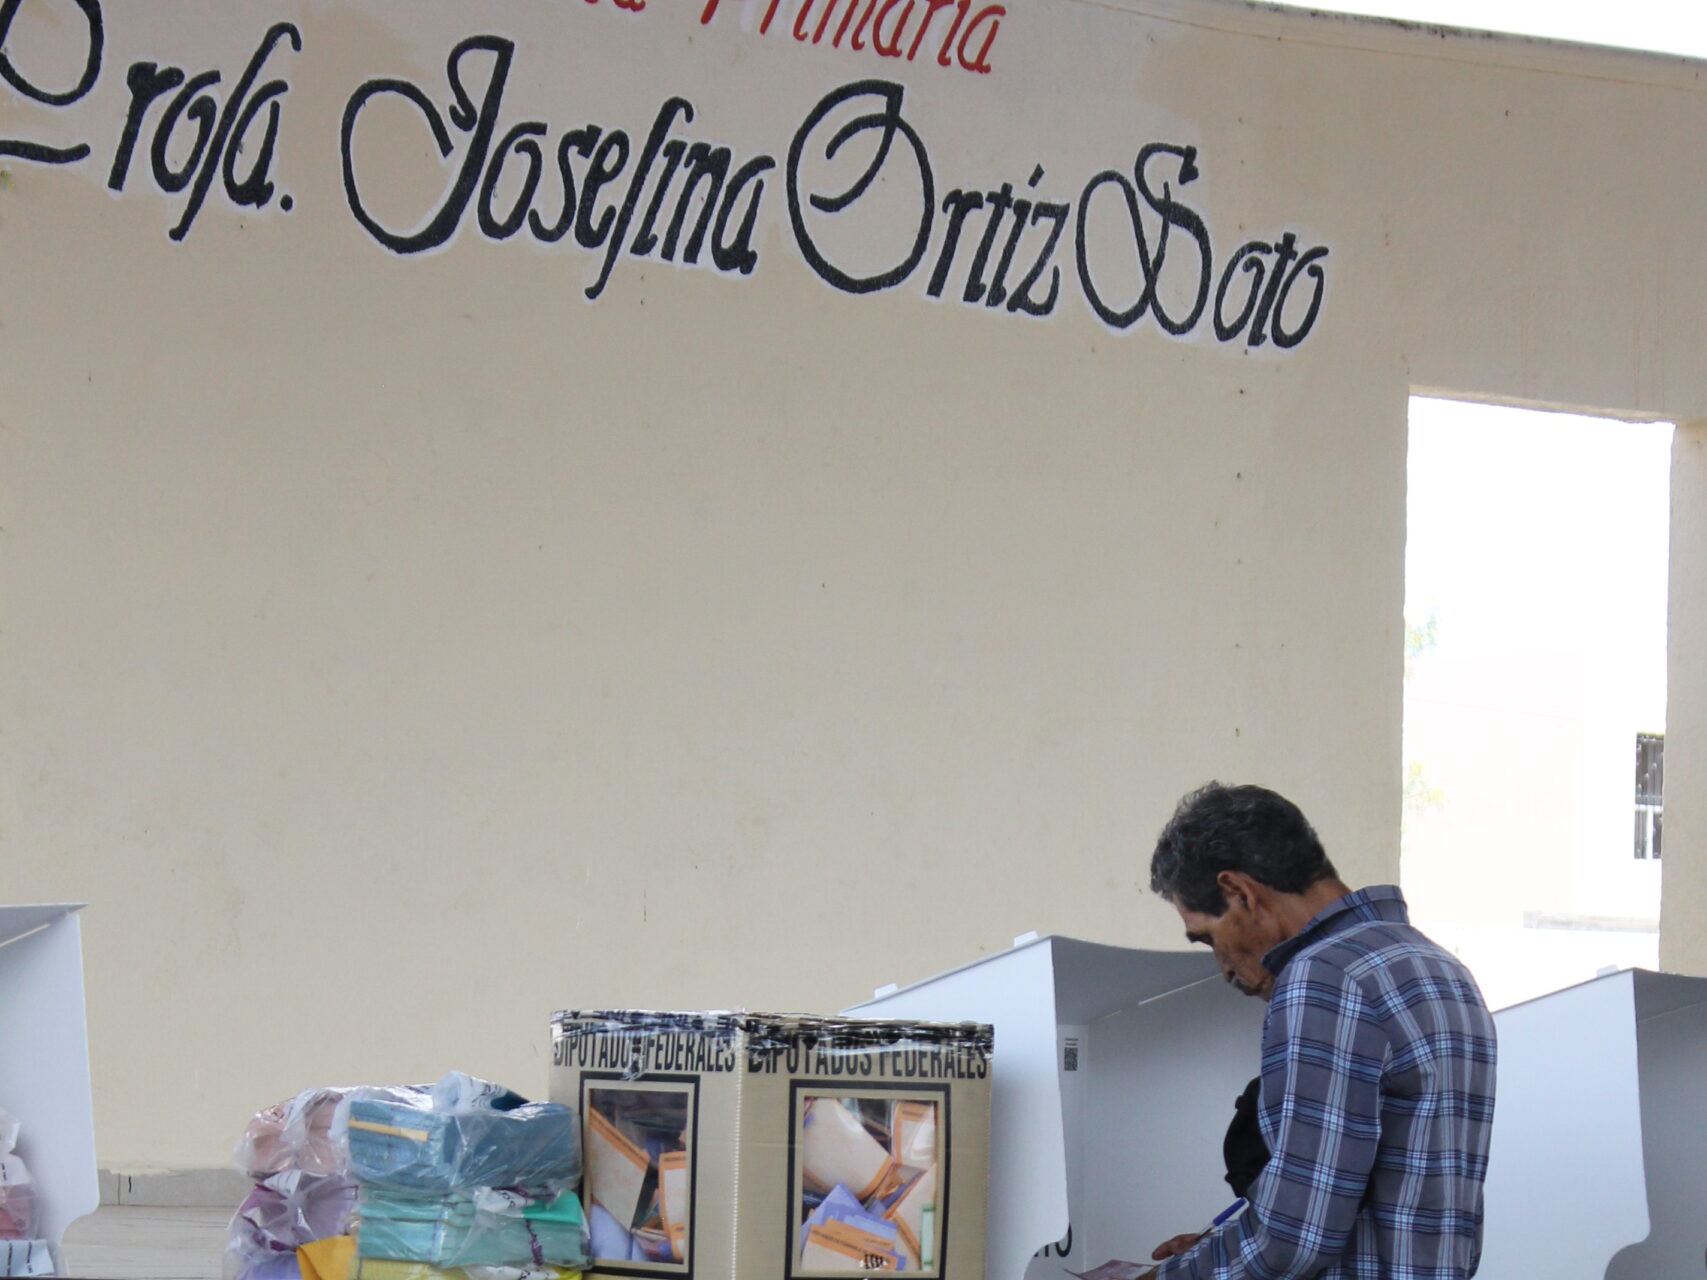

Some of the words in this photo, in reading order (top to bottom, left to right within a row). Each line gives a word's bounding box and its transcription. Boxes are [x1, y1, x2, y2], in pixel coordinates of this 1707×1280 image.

[700, 0, 1006, 74] rimaria
[340, 34, 776, 300] Josefina
[786, 78, 1071, 316] Ortiz
[1075, 141, 1330, 348] Soto
[553, 1030, 641, 1068] DIPUTADO
